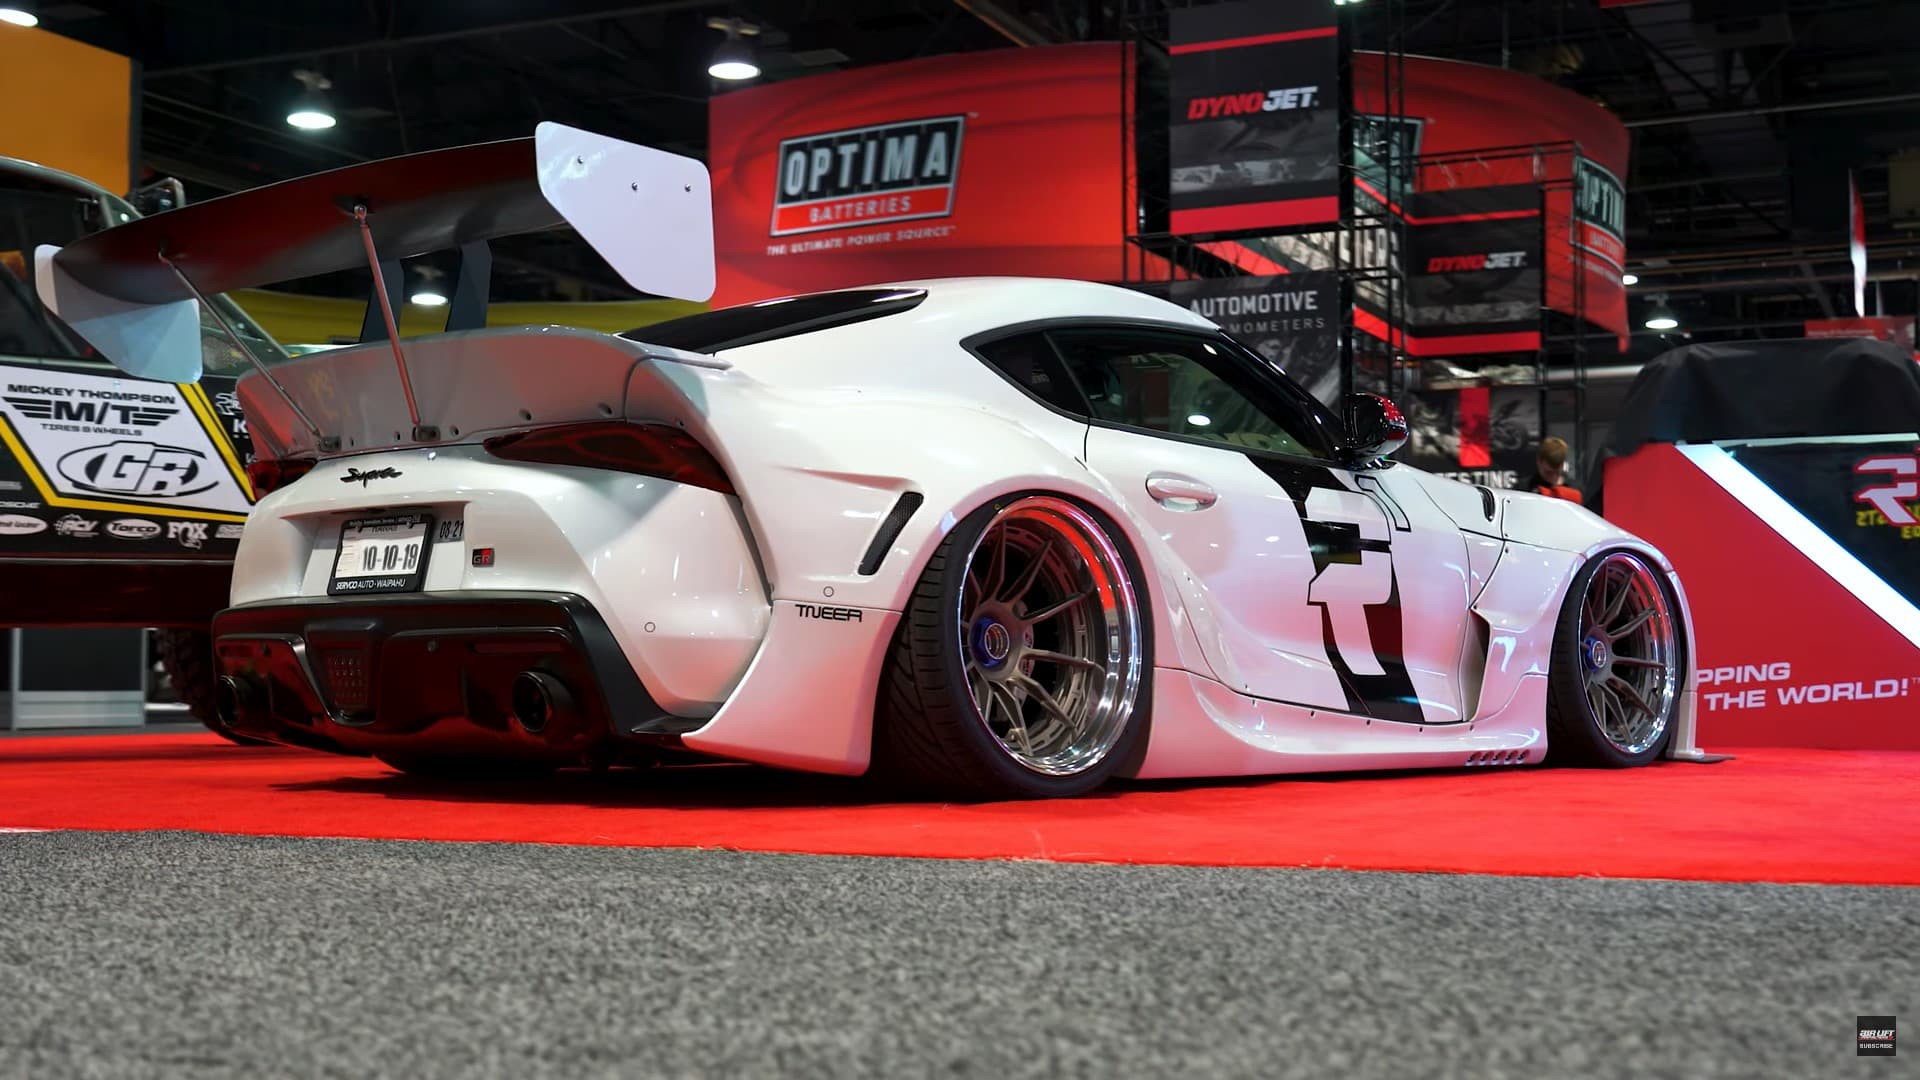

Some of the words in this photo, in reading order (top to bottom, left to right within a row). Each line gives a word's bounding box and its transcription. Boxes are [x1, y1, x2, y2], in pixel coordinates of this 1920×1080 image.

[1187, 86, 1318, 120] DYNOJET
[784, 131, 948, 197] OPTIMA
[809, 196, 912, 223] BATTERIES
[766, 245, 787, 256] THE
[790, 238, 842, 254] ULTIMATE
[1427, 252, 1526, 273] DYNOJET
[1189, 290, 1318, 318] AUTOMOTIVE
[1222, 317, 1325, 334] MOMETERS
[8, 384, 73, 397] MICKEY
[77, 388, 176, 404] THOMPSON
[41, 423, 81, 433] TIRES
[93, 427, 143, 437] WHEELS
[340, 467, 403, 488] Supra
[362, 544, 419, 571] 10-10-19
[1704, 690, 1766, 711] THE
[1777, 678, 1908, 705] WORLD!
